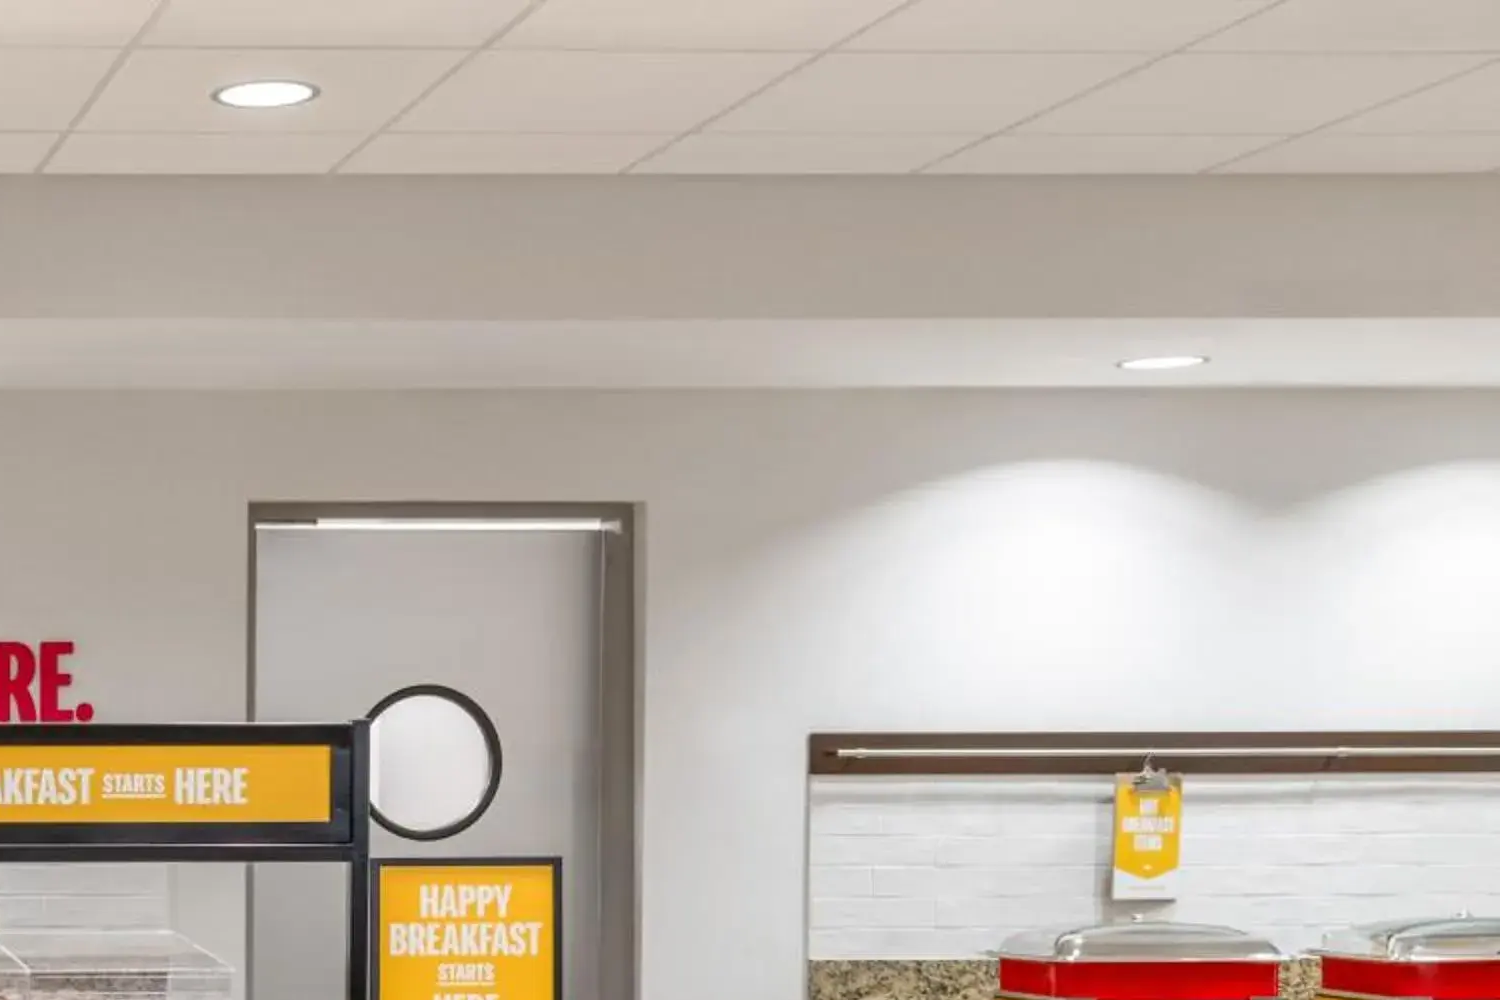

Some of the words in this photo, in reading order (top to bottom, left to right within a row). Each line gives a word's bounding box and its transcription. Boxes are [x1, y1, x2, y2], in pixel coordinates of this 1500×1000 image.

[102, 773, 165, 794] STARTS
[174, 767, 249, 805] HERE
[419, 882, 513, 919] HAPPY
[389, 921, 543, 958] BREAKFAST
[437, 962, 495, 982] STARTS
